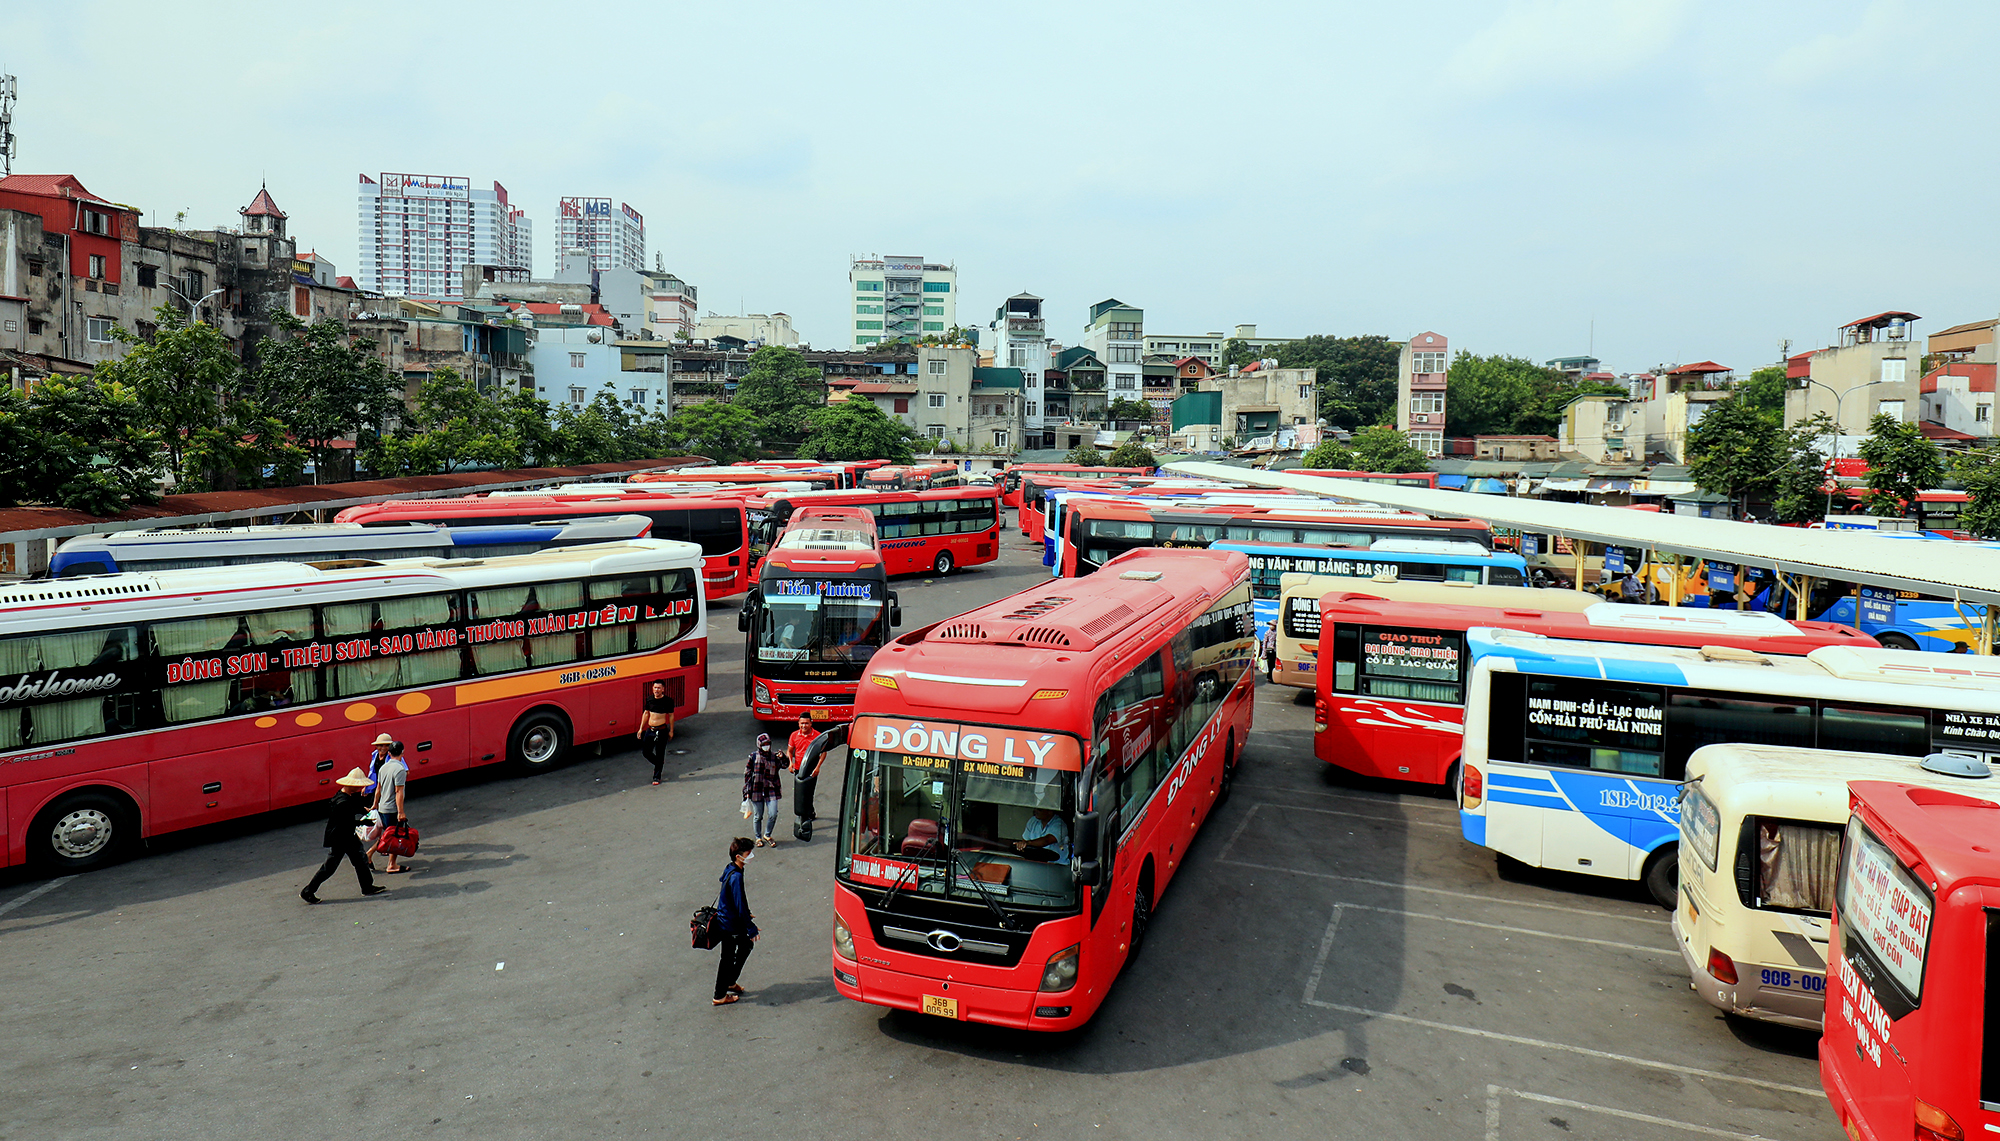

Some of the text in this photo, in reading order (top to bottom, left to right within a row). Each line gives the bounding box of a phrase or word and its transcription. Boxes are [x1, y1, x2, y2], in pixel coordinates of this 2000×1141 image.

[585, 202, 610, 215] MB
[886, 263, 922, 271] mobifone
[1373, 564, 1399, 576] SAO
[776, 579, 872, 600] Tiến Phương
[567, 604, 637, 630] HIỀN
[1379, 633, 1408, 642] GIAO
[167, 656, 222, 683] ĐÔNG
[227, 651, 268, 676] SƠN
[281, 642, 332, 668] TRIỆU
[527, 613, 566, 636] XUÂN
[1528, 697, 1552, 710] NAM
[1945, 713, 1968, 724] NHÀ
[1969, 715, 1983, 725] XE
[1631, 721, 1662, 735] NINH
[1943, 725, 1964, 736] Kính
[1964, 728, 1987, 738] Chào
[874, 722, 1056, 766] ĐÔNG LÝ
[1167, 706, 1223, 806] ĐÔNG LÝ
[964, 762, 975, 772] BX
[852, 859, 870, 876] THANH
[869, 860, 881, 878] HÓA
[1891, 887, 1910, 921] GIÁP
[1909, 905, 1928, 939] BÁT
[1873, 927, 1886, 953] CHỢ
[932, 997, 948, 1008] 36B
[1839, 953, 1860, 1003] TIẾN
[1859, 984, 1891, 1044] DŨNG
[926, 1005, 954, 1017] 005.99
